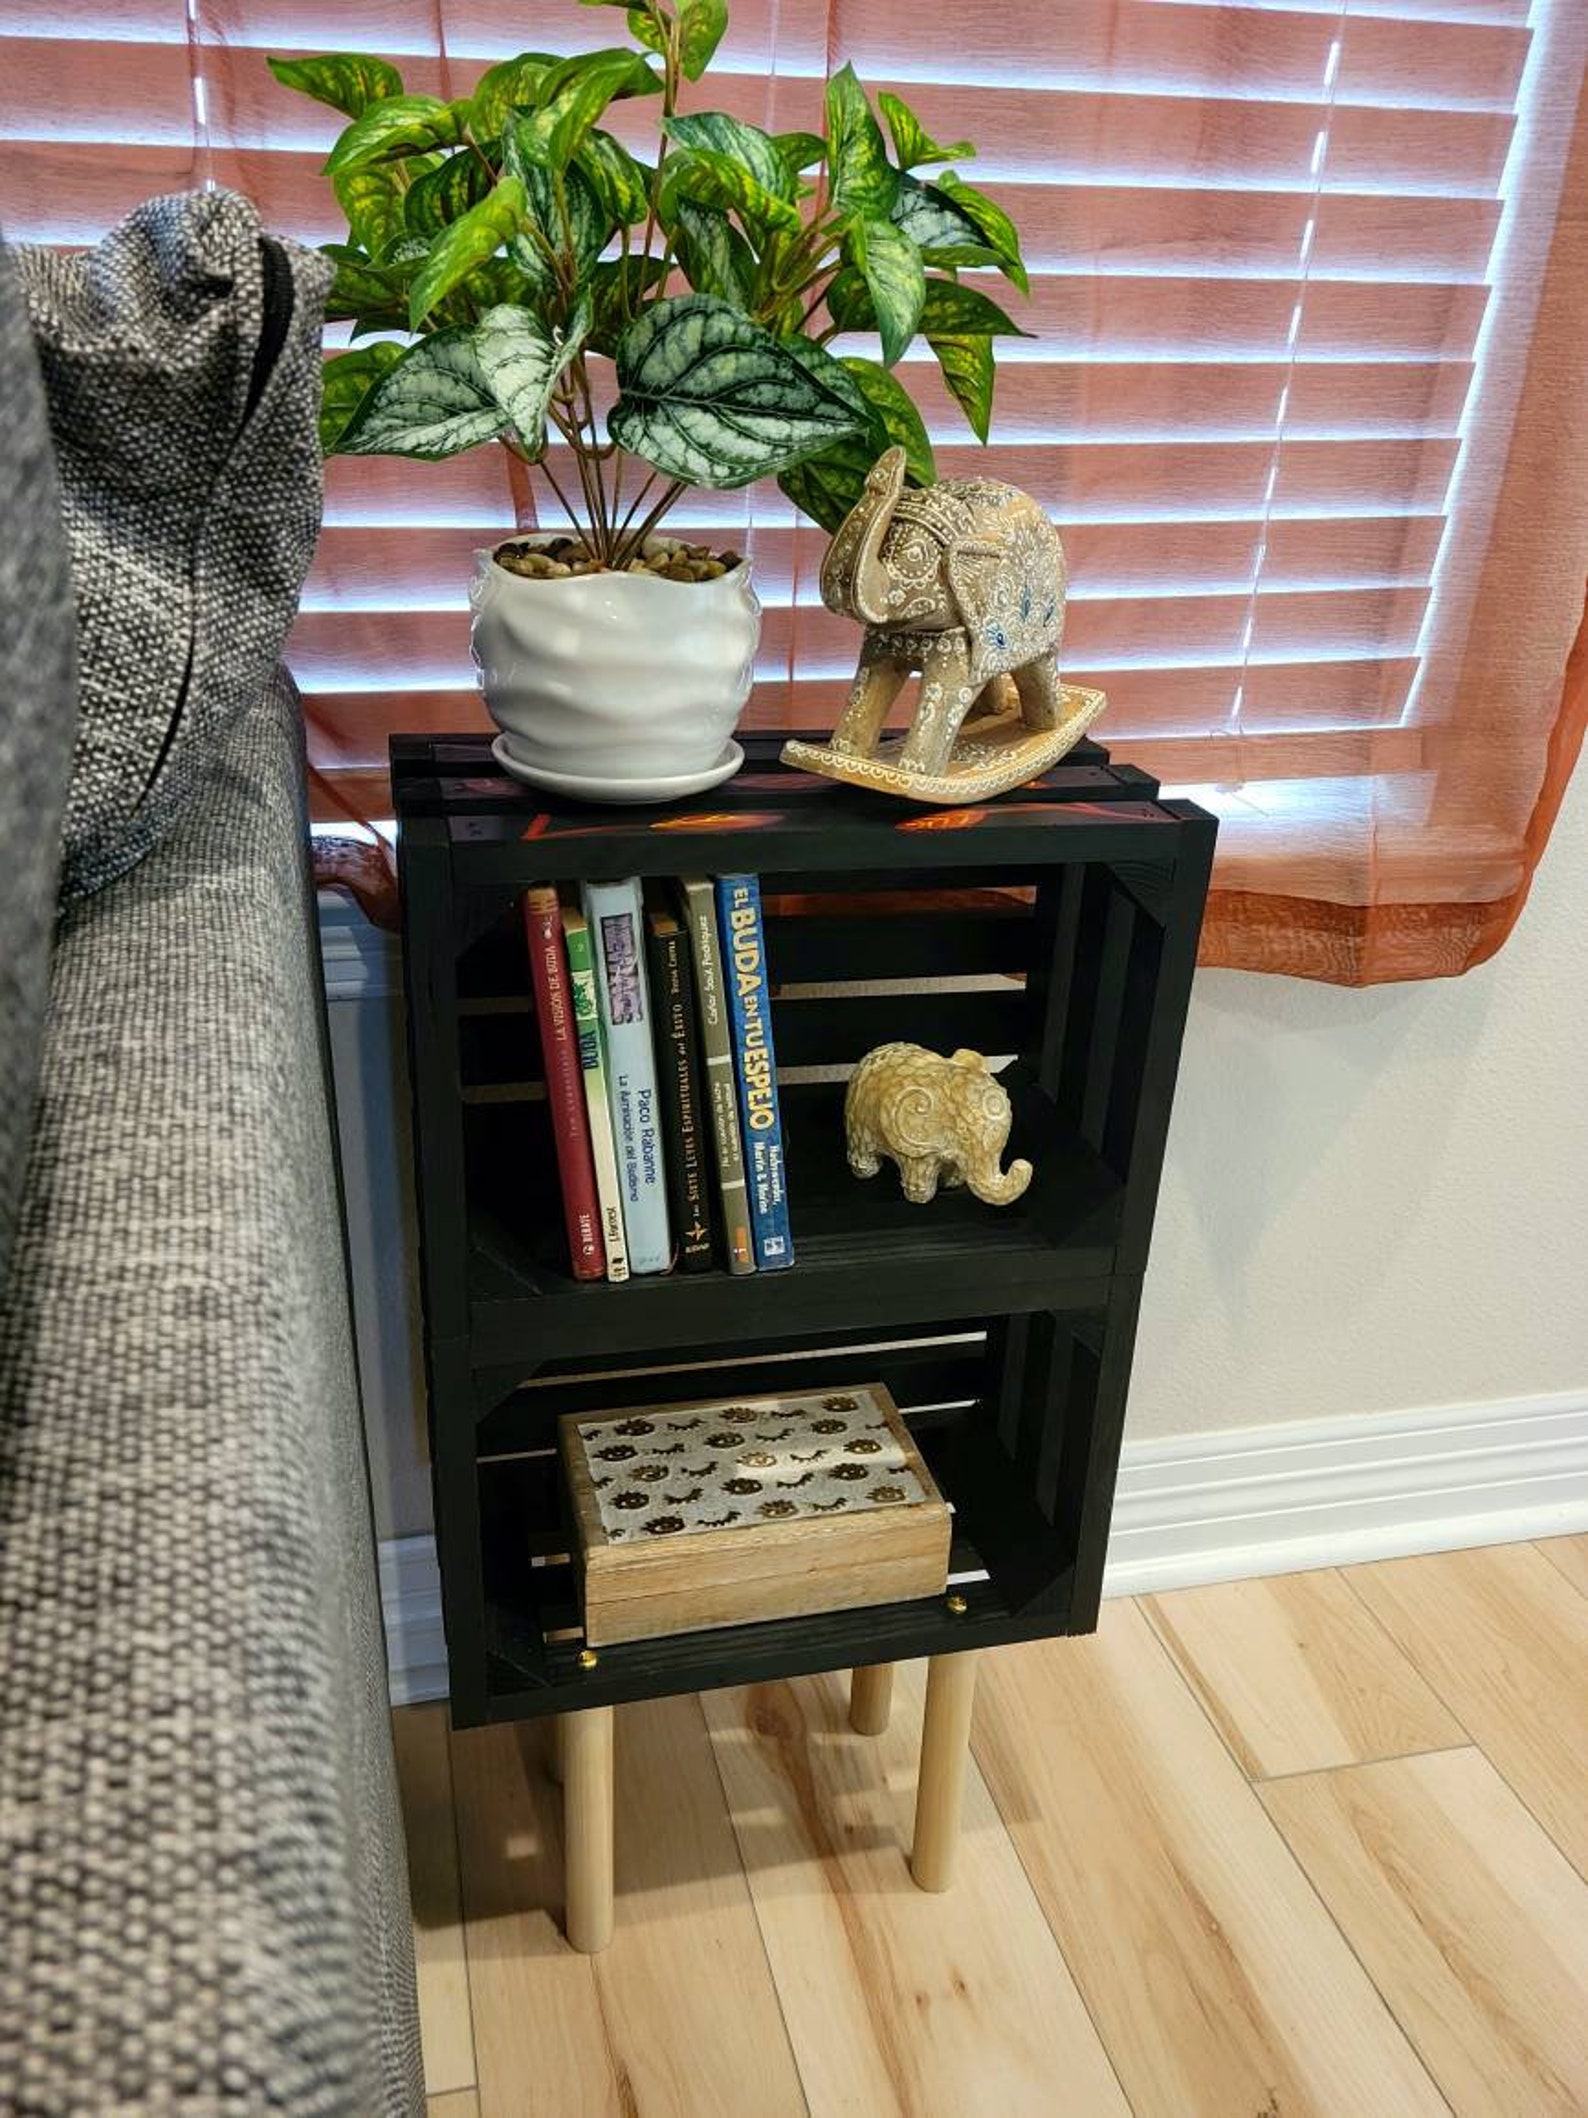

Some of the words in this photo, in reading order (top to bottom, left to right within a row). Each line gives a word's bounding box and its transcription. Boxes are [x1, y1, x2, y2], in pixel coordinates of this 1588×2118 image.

[733, 888, 749, 908] EL
[545, 946, 558, 974] BUDA
[731, 907, 762, 997] BUDA
[548, 976, 560, 990] DE
[744, 995, 758, 1018] EN
[744, 1018, 764, 1047] TU
[580, 1030, 599, 1070] BUDA
[744, 1047, 774, 1131] ESPEJO
[638, 1090, 652, 1123] Paco
[641, 1128, 657, 1185] Rabanne
